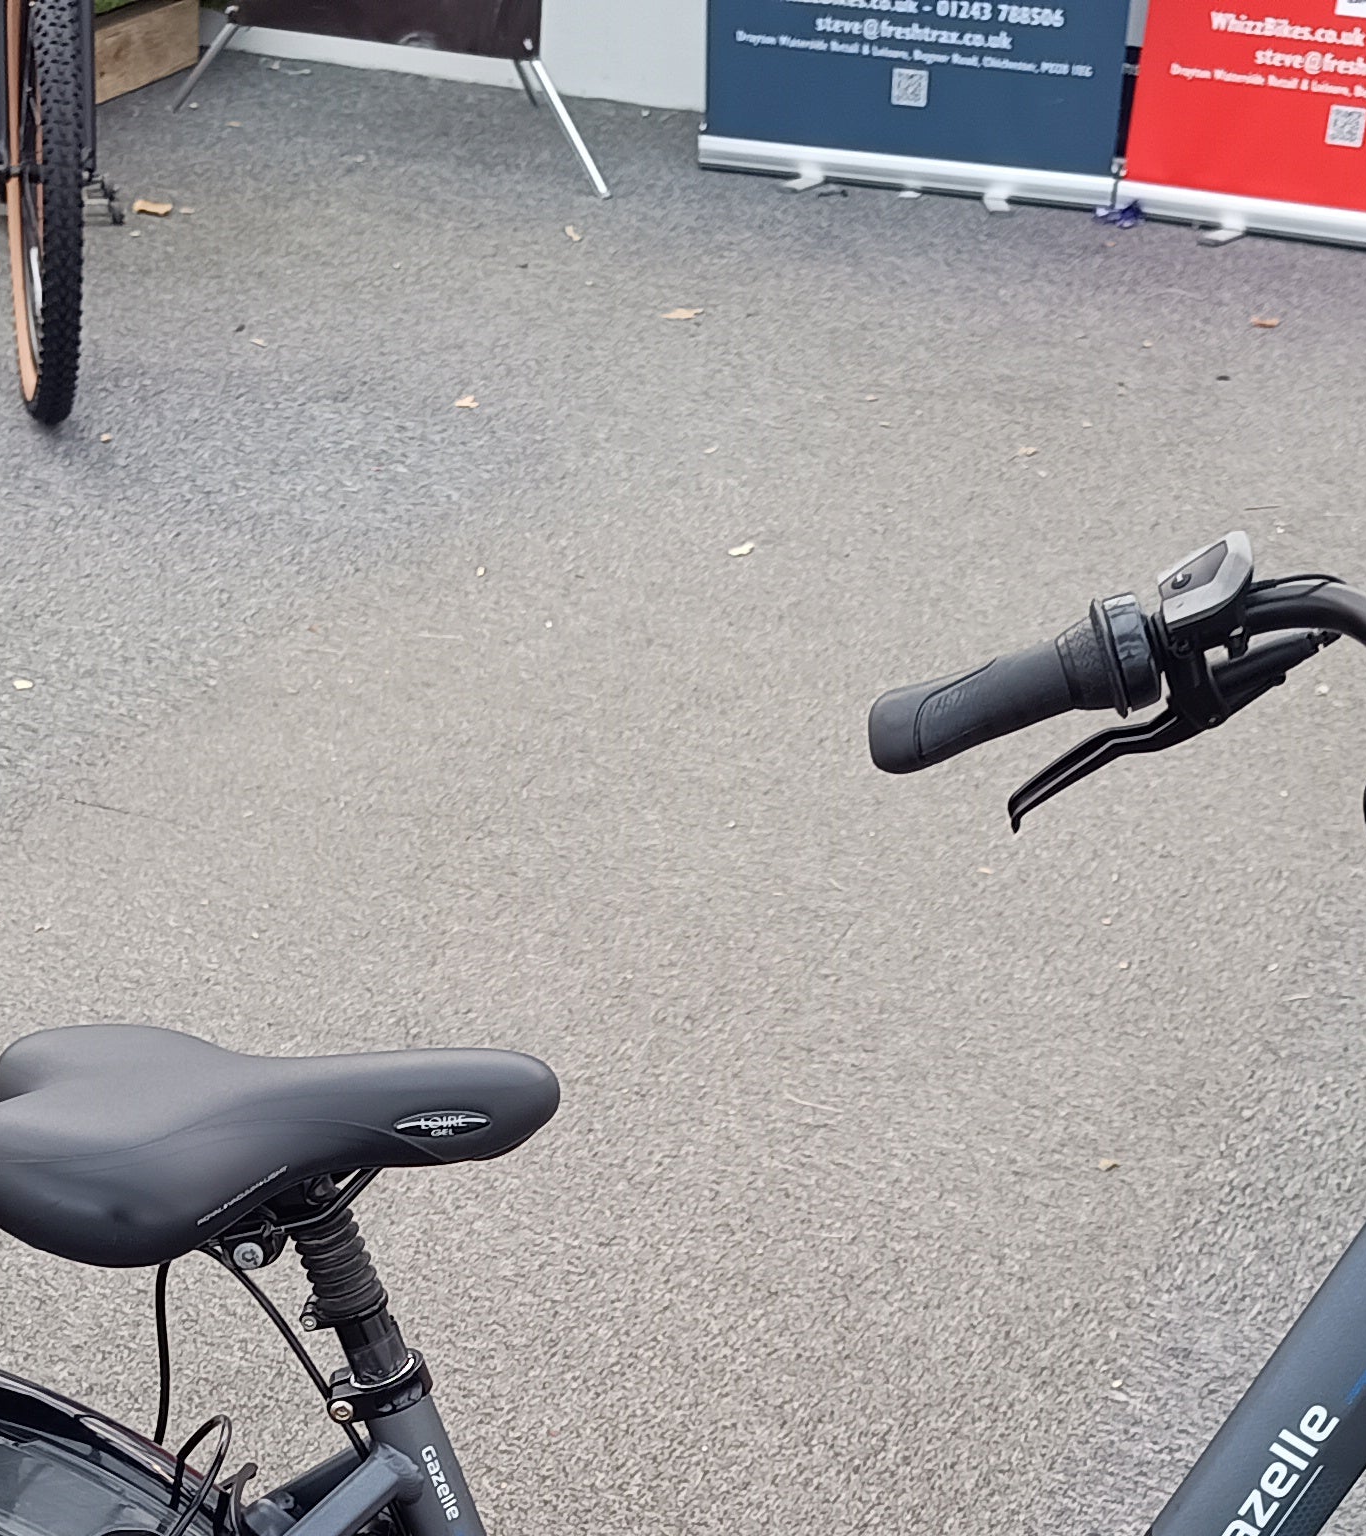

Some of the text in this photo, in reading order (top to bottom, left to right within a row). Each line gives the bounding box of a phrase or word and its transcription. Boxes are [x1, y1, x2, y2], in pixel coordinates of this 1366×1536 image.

[936, 0, 992, 21] 01243
[814, 15, 1013, 50] steve@freshtrax.co.uk
[420, 1115, 468, 1130] LOIRE
[431, 1128, 455, 1137] GEL
[421, 1445, 460, 1521] Gazelle
